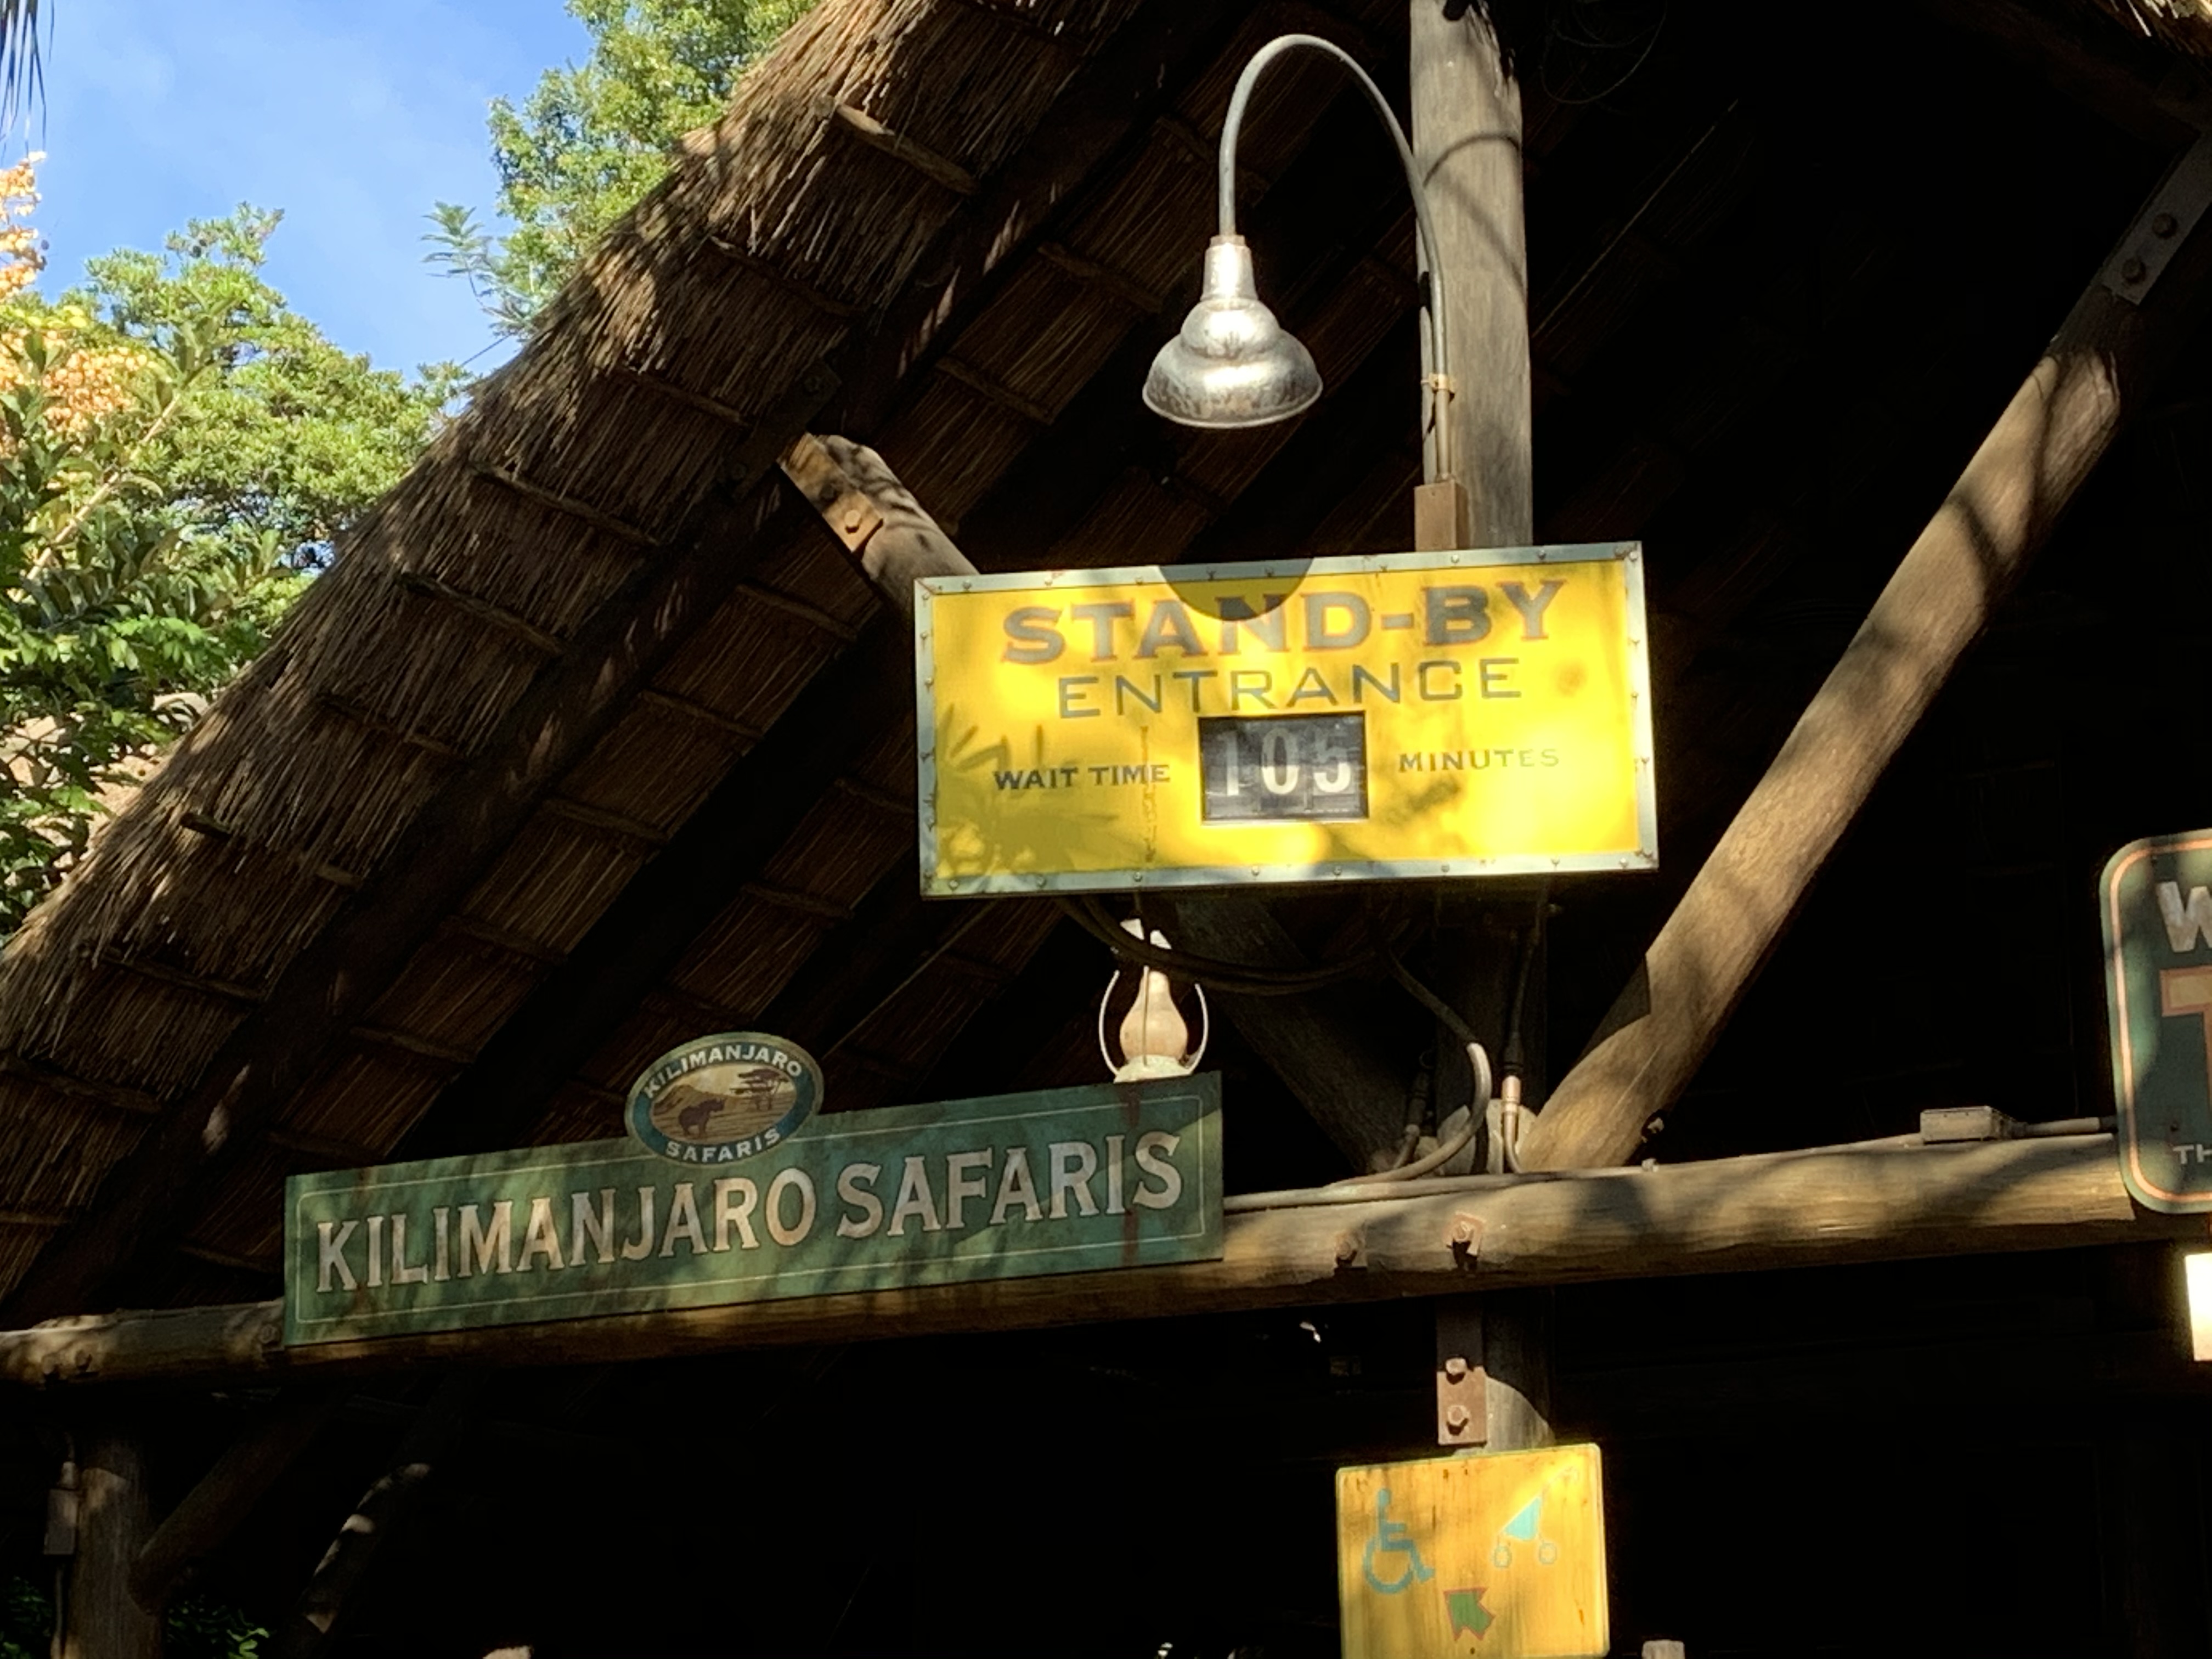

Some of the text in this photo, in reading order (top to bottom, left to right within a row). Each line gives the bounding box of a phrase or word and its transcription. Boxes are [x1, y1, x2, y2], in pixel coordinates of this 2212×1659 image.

[1002, 579, 1565, 664] STAND-BY
[1058, 658, 1522, 719] ENTRANCE
[995, 725, 1560, 797] WAIT TIME 105 MINUTES
[645, 1045, 802, 1098] KILIMANJARO
[665, 1128, 780, 1163] SAFARIS
[317, 1131, 1182, 1293] KILIMANJARO SAFARIS
